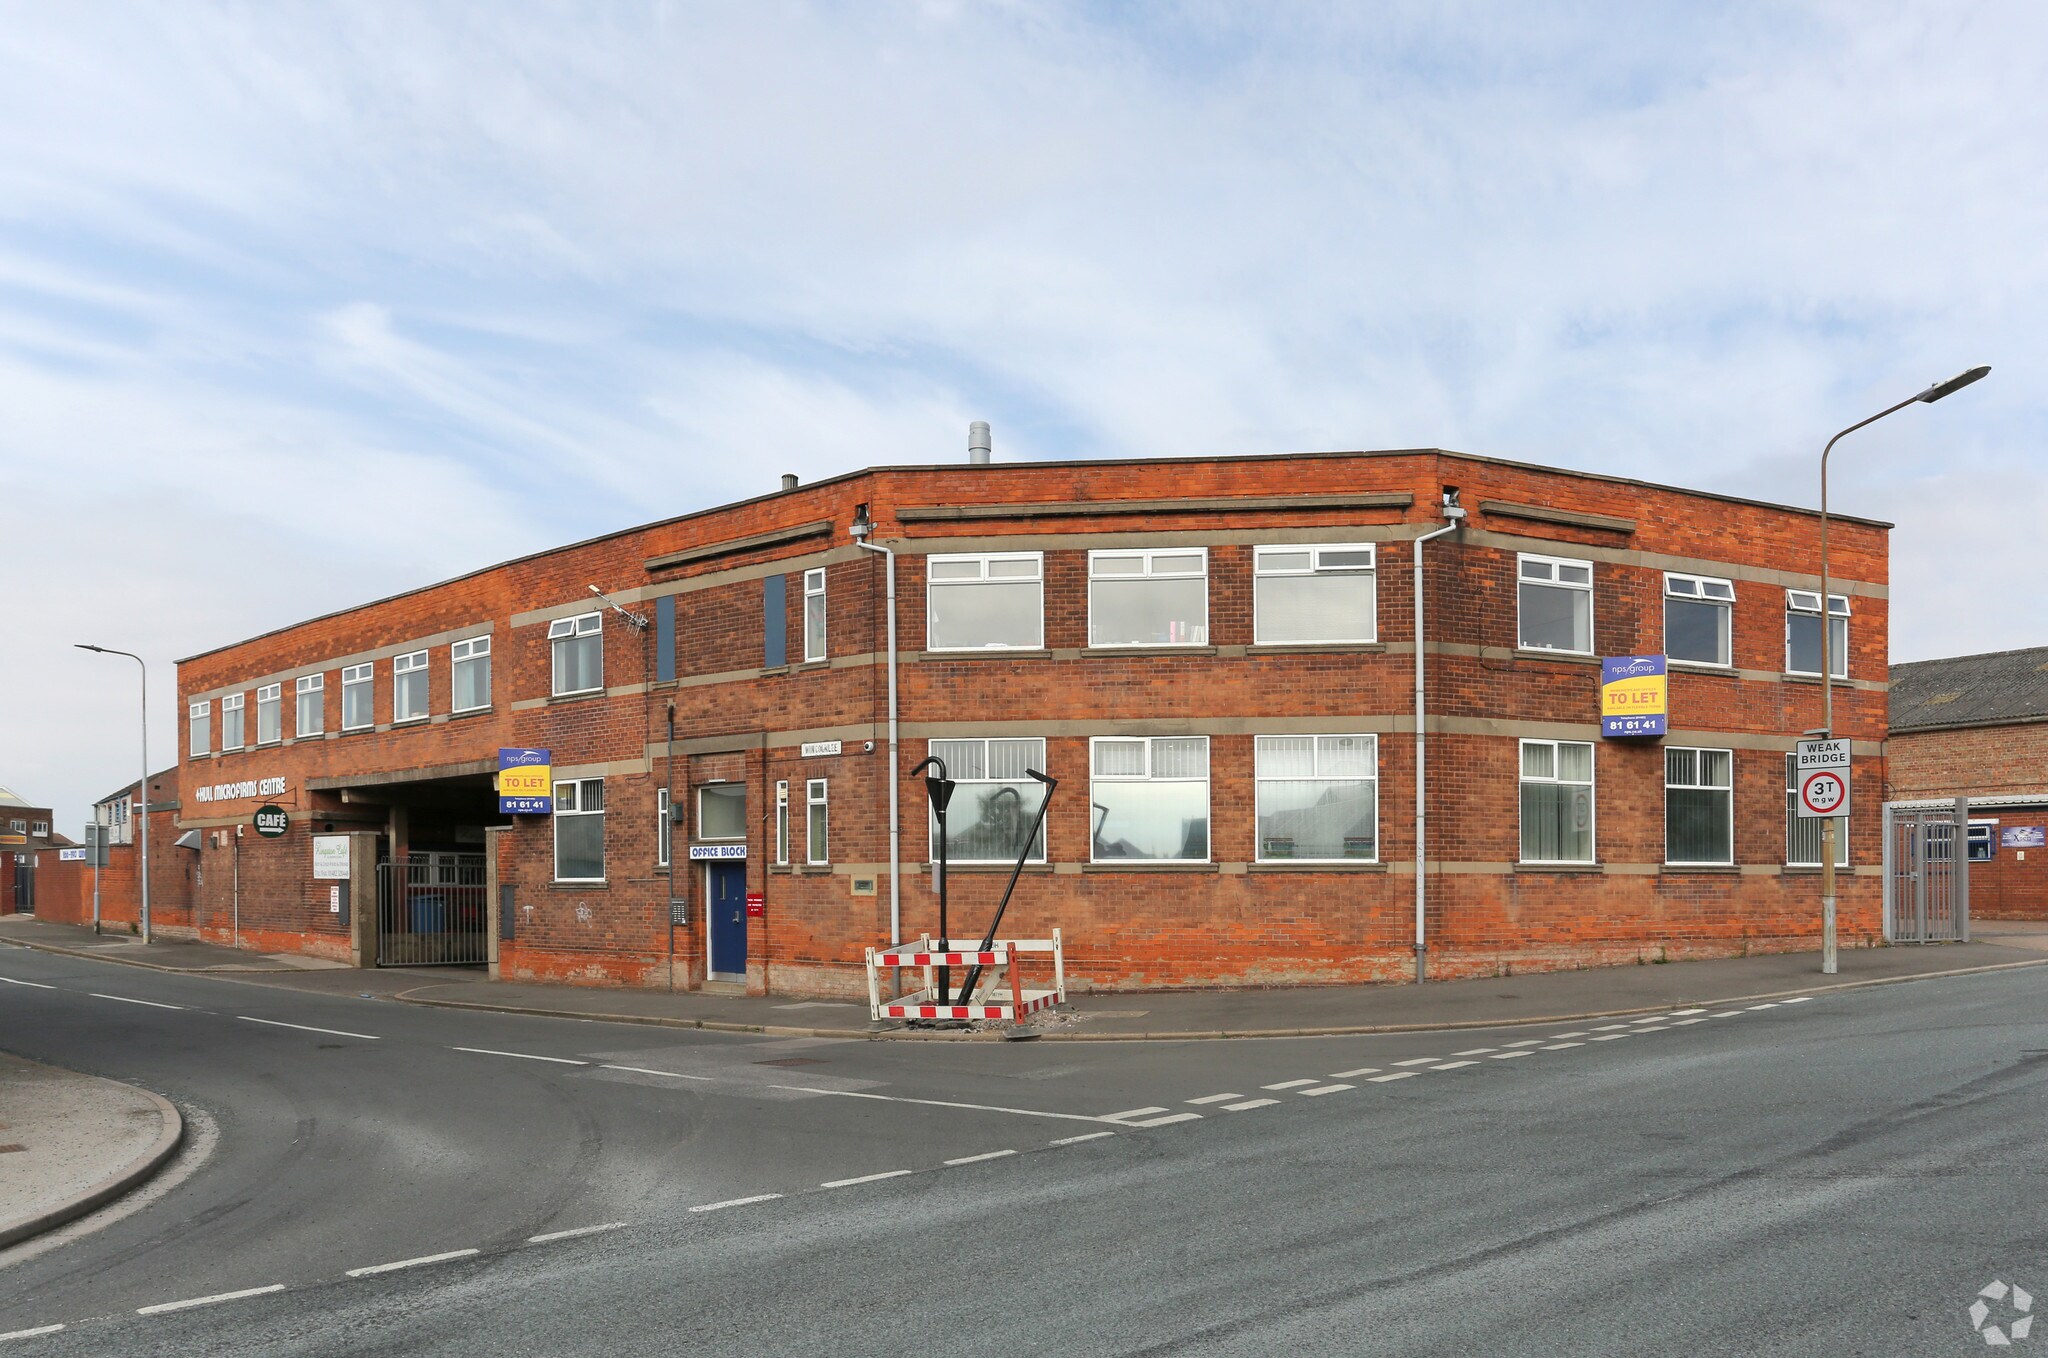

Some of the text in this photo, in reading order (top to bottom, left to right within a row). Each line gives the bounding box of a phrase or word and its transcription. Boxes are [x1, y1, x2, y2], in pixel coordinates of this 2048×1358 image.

[1630, 665, 1655, 674] group
[1609, 692, 1658, 704] TO LET
[1610, 720, 1656, 730] 81 61 41
[1807, 742, 1840, 752] WEAK
[1802, 753, 1846, 764] BRIDGE
[259, 776, 286, 796] CENTRE
[505, 778, 544, 787] TO LET
[257, 813, 286, 827] CAFÉ
[692, 847, 745, 857] OFFICE BLOCK
